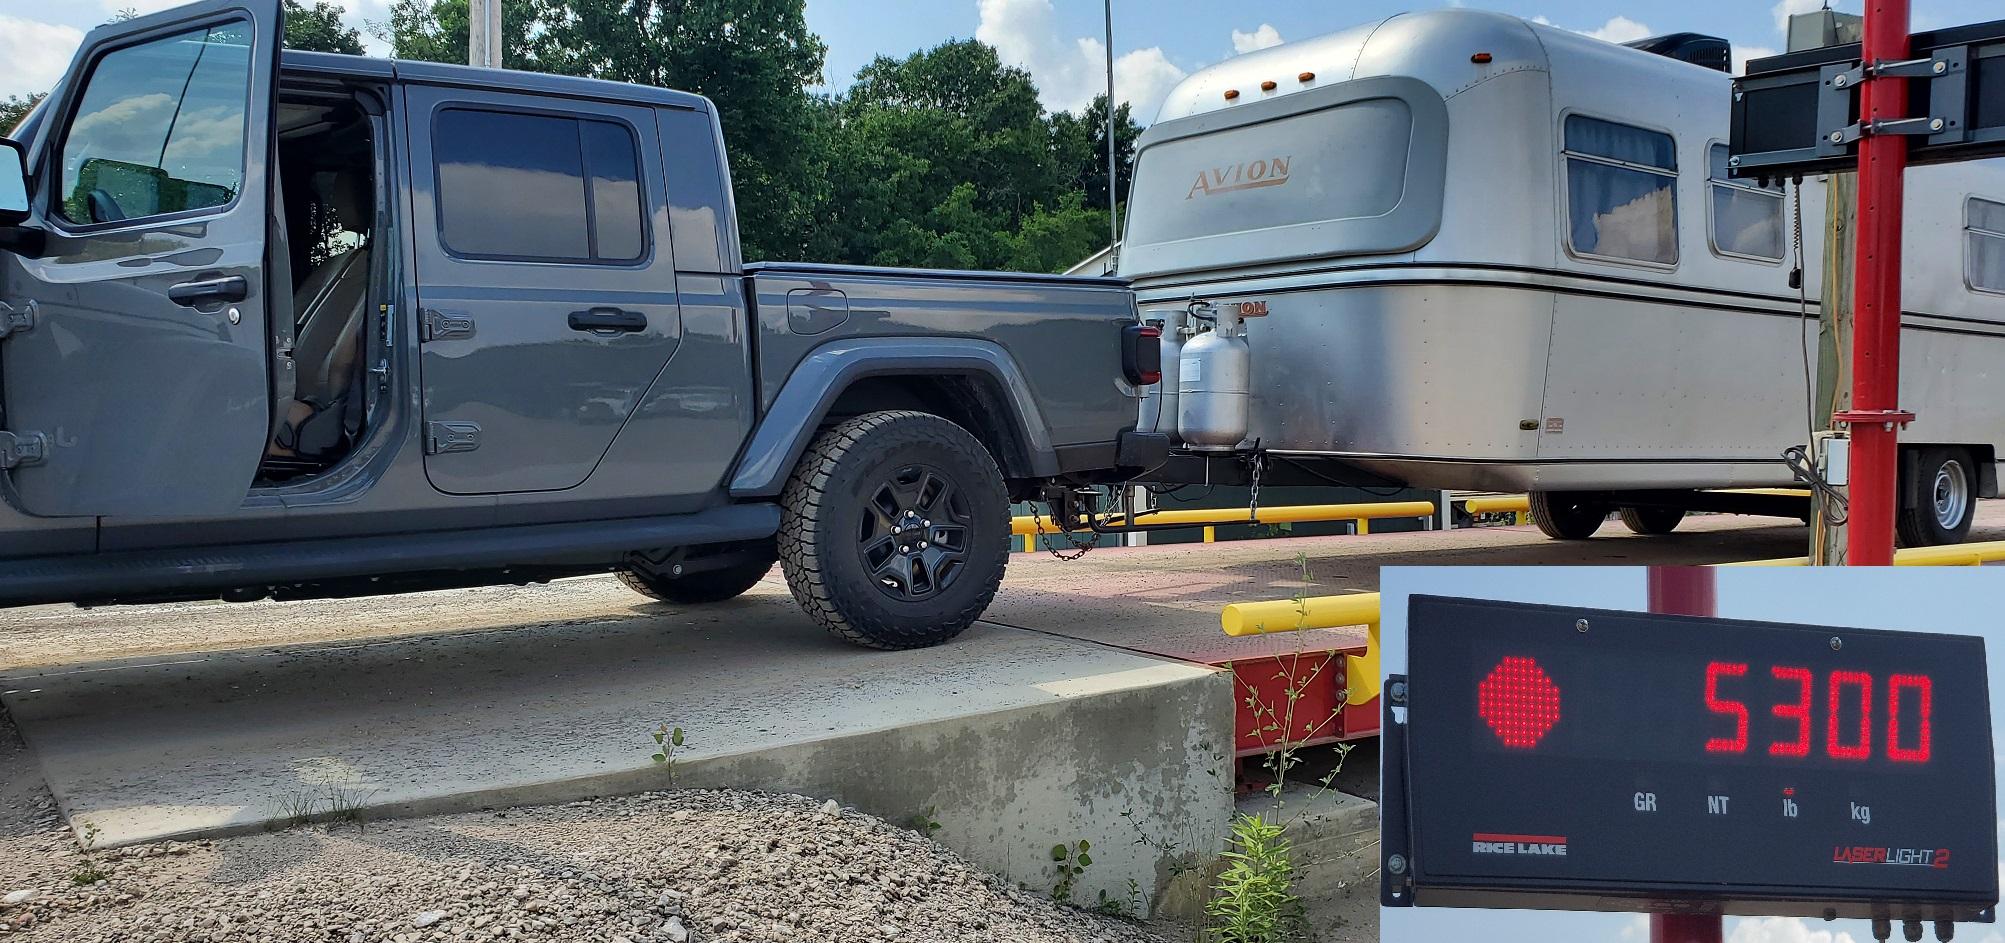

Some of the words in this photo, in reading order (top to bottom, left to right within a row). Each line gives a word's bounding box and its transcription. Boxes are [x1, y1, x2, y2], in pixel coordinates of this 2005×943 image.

[1185, 155, 1291, 200] AVION
[1705, 662, 1932, 762] 5300
[1634, 792, 1657, 812] GR
[1707, 795, 1730, 815] NT
[1783, 798, 1798, 818] lb
[1850, 802, 1871, 824] kg
[1472, 841, 1515, 854] RICE
[1517, 843, 1567, 856] LAKE
